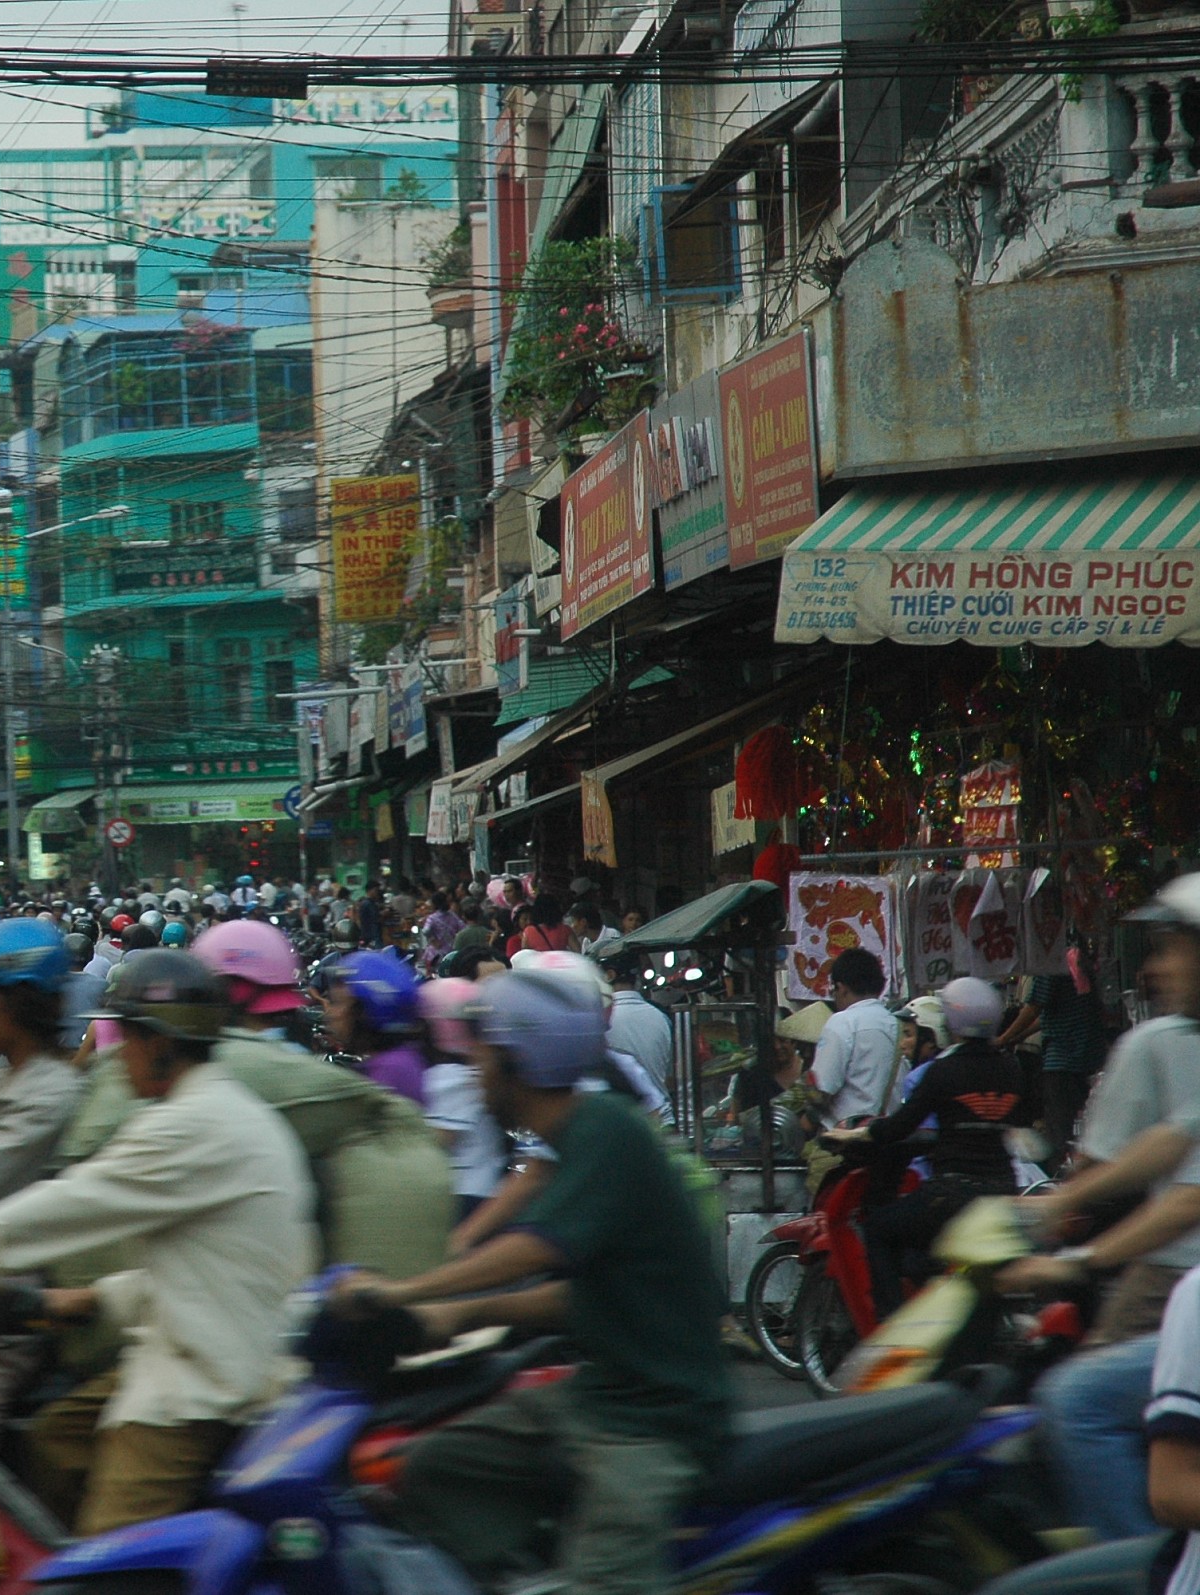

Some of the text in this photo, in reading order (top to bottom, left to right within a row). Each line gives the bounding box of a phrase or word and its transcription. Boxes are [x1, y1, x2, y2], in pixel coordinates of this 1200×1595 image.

[342, 537, 359, 550] IN
[813, 557, 846, 577] 132
[968, 554, 1073, 589] HỒNG
[1087, 552, 1195, 589] PHÚC
[1022, 595, 1082, 616] KIM
[1093, 595, 1186, 619] NGỌC
[906, 617, 981, 635] CHUYÊN
[988, 621, 1042, 635] CUNG
[1120, 619, 1133, 635] &
